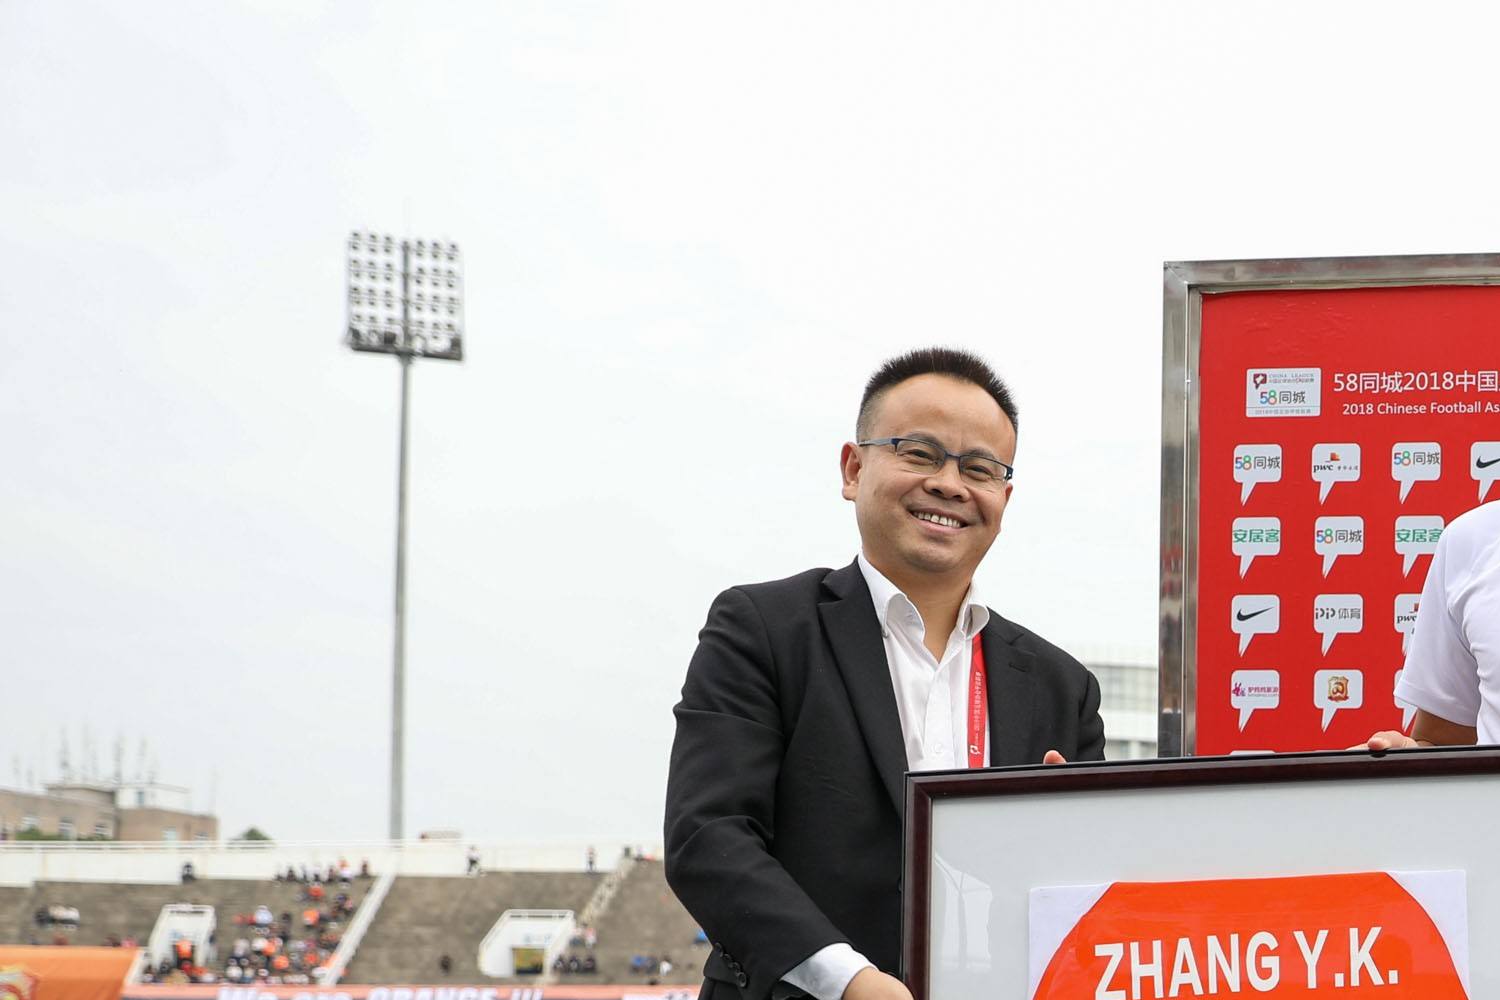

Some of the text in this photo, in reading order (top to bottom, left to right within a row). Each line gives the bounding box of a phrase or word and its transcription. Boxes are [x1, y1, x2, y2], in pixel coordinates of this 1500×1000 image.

[1260, 389, 1306, 405] 58同城
[1342, 403, 1374, 415] 2018
[1377, 403, 1426, 415] Chinese
[1430, 402, 1481, 414] Football
[1235, 455, 1281, 471] 58同城
[1394, 450, 1441, 466] 58同城
[1313, 464, 1334, 473] pwc
[1232, 529, 1280, 543] 安居客
[1316, 528, 1362, 544] 58同城
[1396, 529, 1443, 543] 安居客
[1293, 926, 1399, 989] Y.K.
